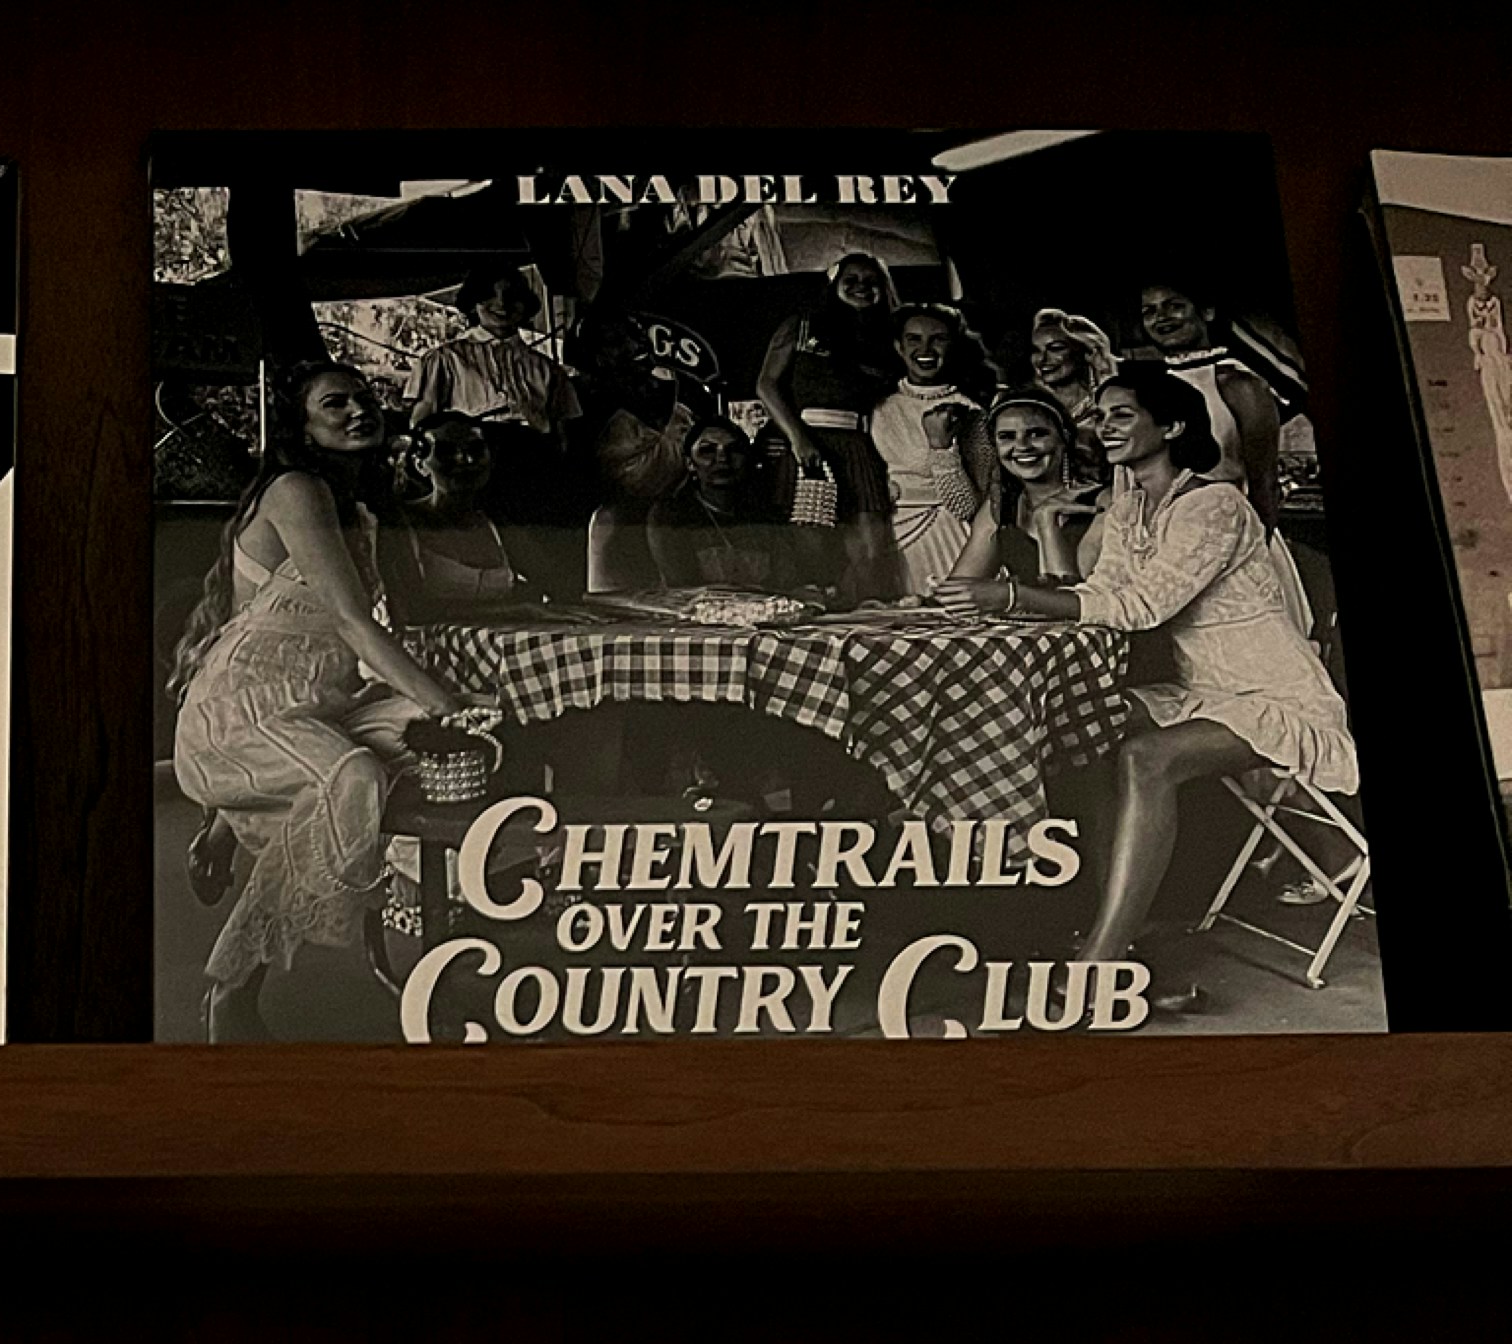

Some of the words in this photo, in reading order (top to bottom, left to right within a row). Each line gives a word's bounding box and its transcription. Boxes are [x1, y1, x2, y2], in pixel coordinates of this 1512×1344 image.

[516, 174, 676, 204] LANA
[694, 174, 818, 204] DEL
[835, 174, 957, 204] REY
[457, 796, 1082, 921] CHEMTRAILS
[554, 901, 722, 952] OVER
[745, 900, 866, 951] THE
[400, 938, 856, 1044] COUNTRY
[879, 934, 1152, 1040] CLUB
